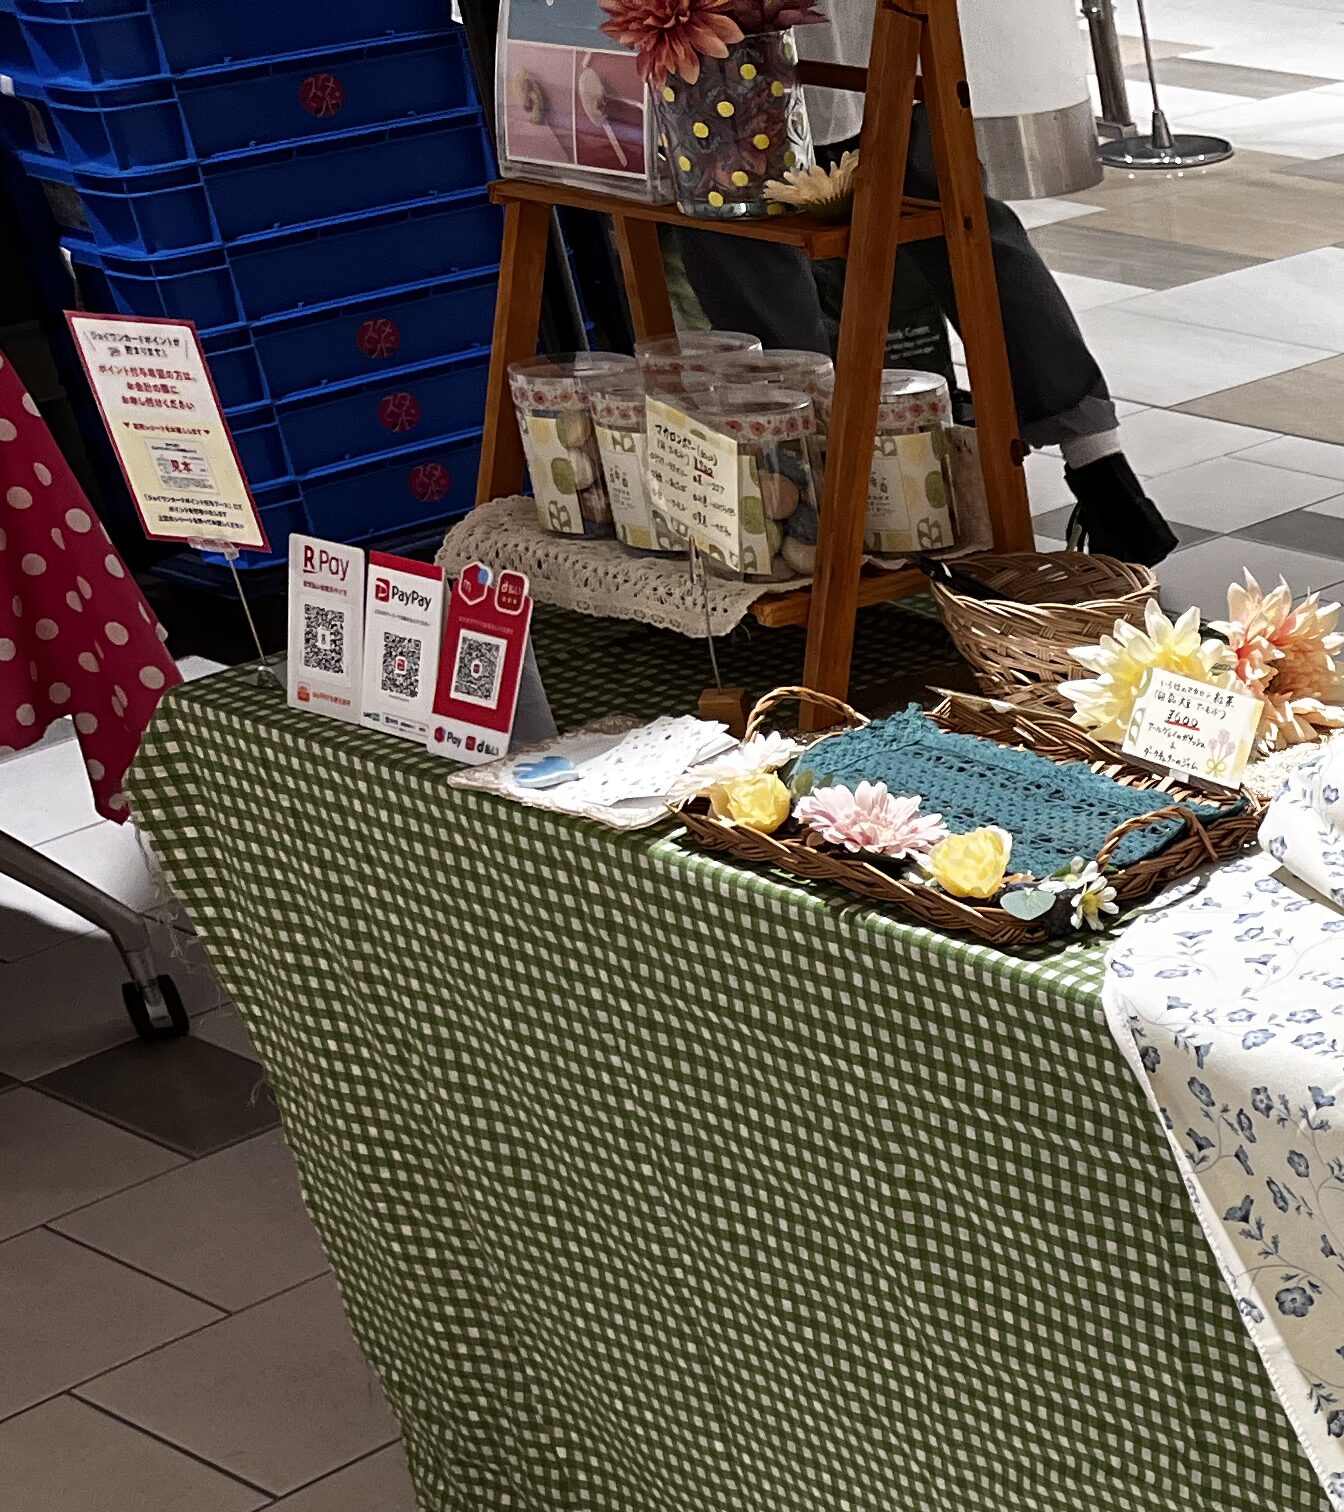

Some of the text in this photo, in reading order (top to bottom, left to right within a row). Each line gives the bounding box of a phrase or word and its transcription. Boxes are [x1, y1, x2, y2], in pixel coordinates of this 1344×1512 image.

[319, 549, 350, 581] Pay
[391, 585, 433, 612] PayPay
[446, 732, 463, 749] Pay
